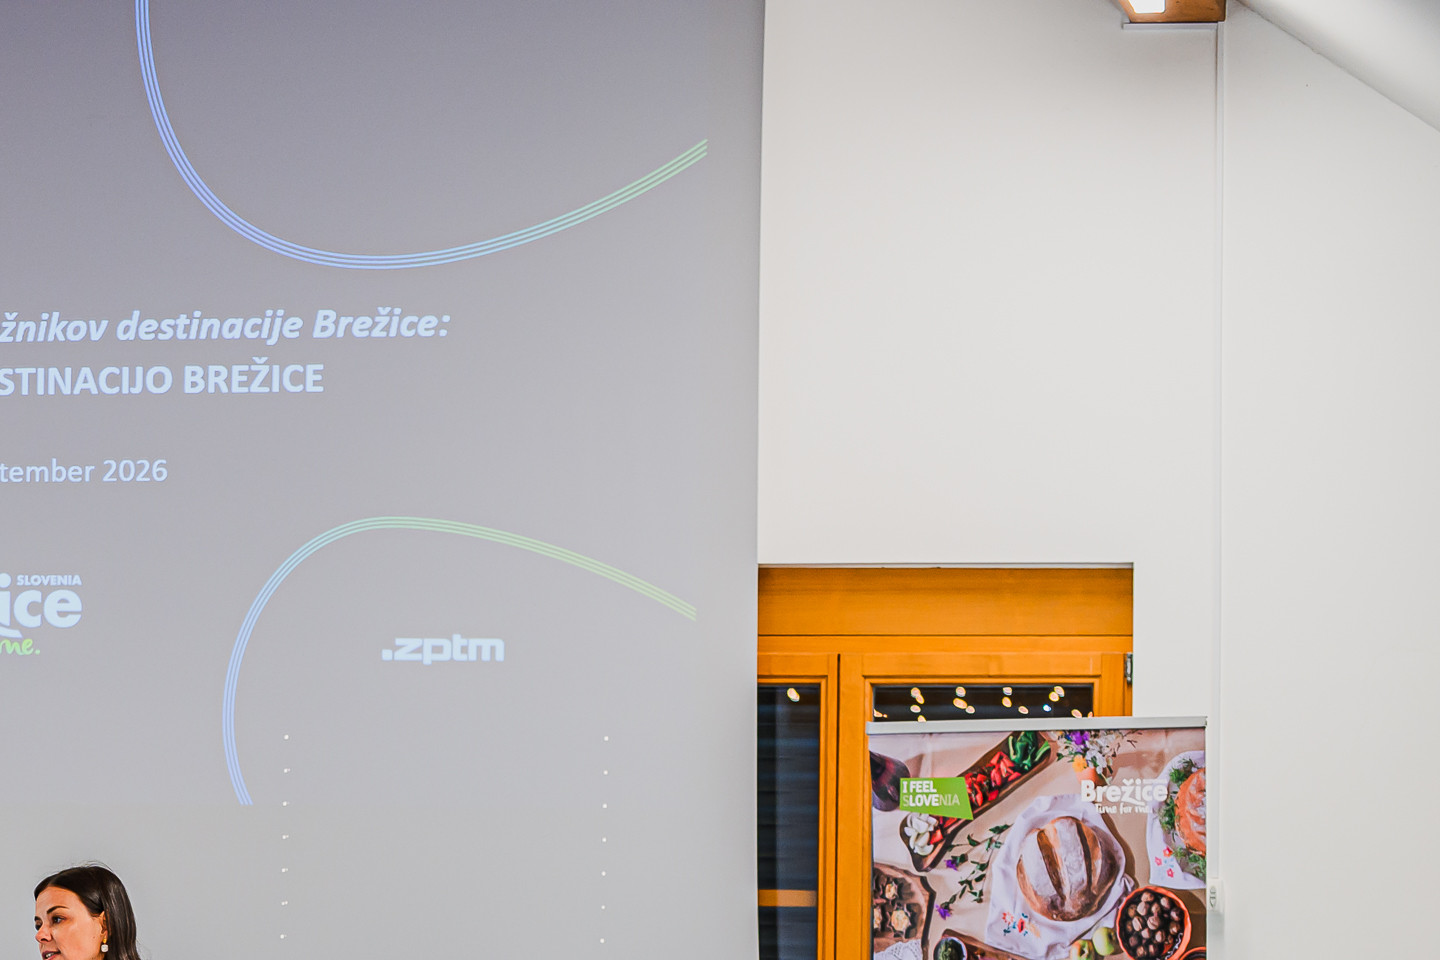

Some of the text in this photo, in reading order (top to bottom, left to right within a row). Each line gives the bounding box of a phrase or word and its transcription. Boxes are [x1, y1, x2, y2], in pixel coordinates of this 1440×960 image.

[116, 309, 304, 346] destinacije
[312, 306, 451, 338] Brežice:
[183, 356, 325, 394] BREŽICE
[102, 458, 169, 483] 2026
[16, 574, 83, 587] SLOVENIA
[902, 780, 937, 793] I FEEL
[1080, 777, 1168, 807] Brežice
[902, 793, 960, 807] SLOVENIA
